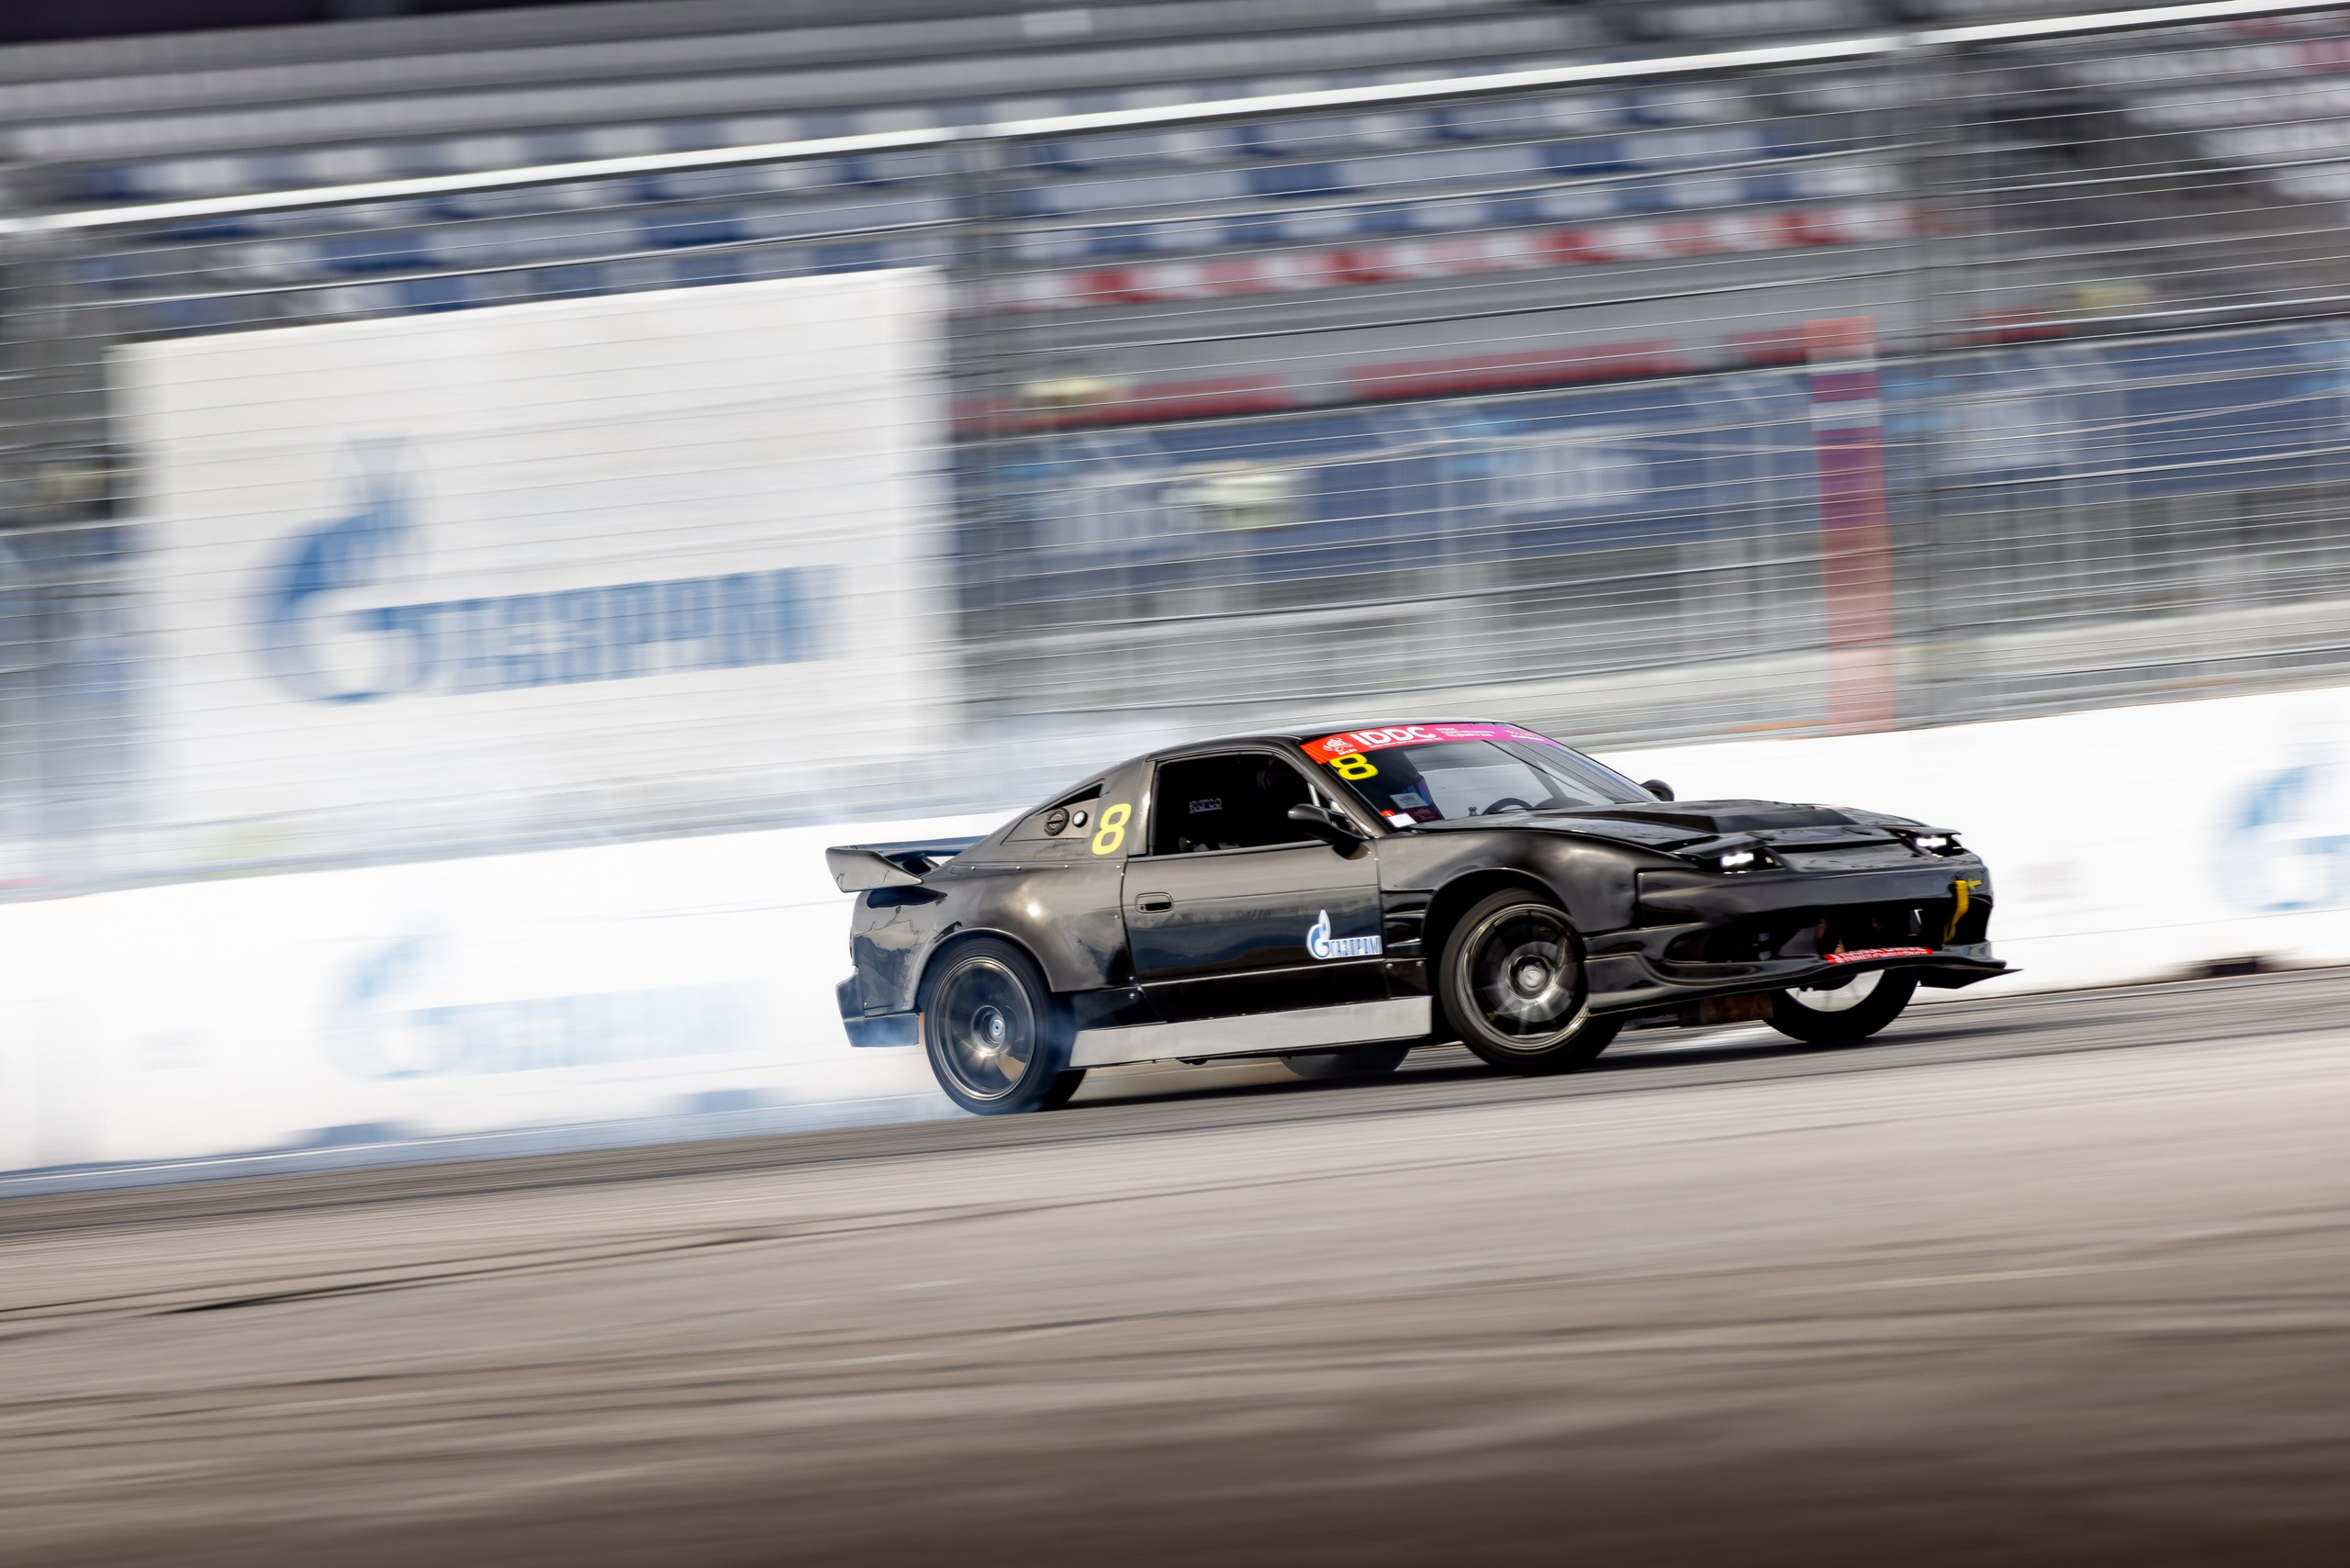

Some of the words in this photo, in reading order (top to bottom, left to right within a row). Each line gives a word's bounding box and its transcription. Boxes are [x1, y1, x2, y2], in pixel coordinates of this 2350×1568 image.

[1349, 726, 1437, 746] IDDC
[1329, 753, 1379, 780] 8
[1091, 802, 1133, 856] 8
